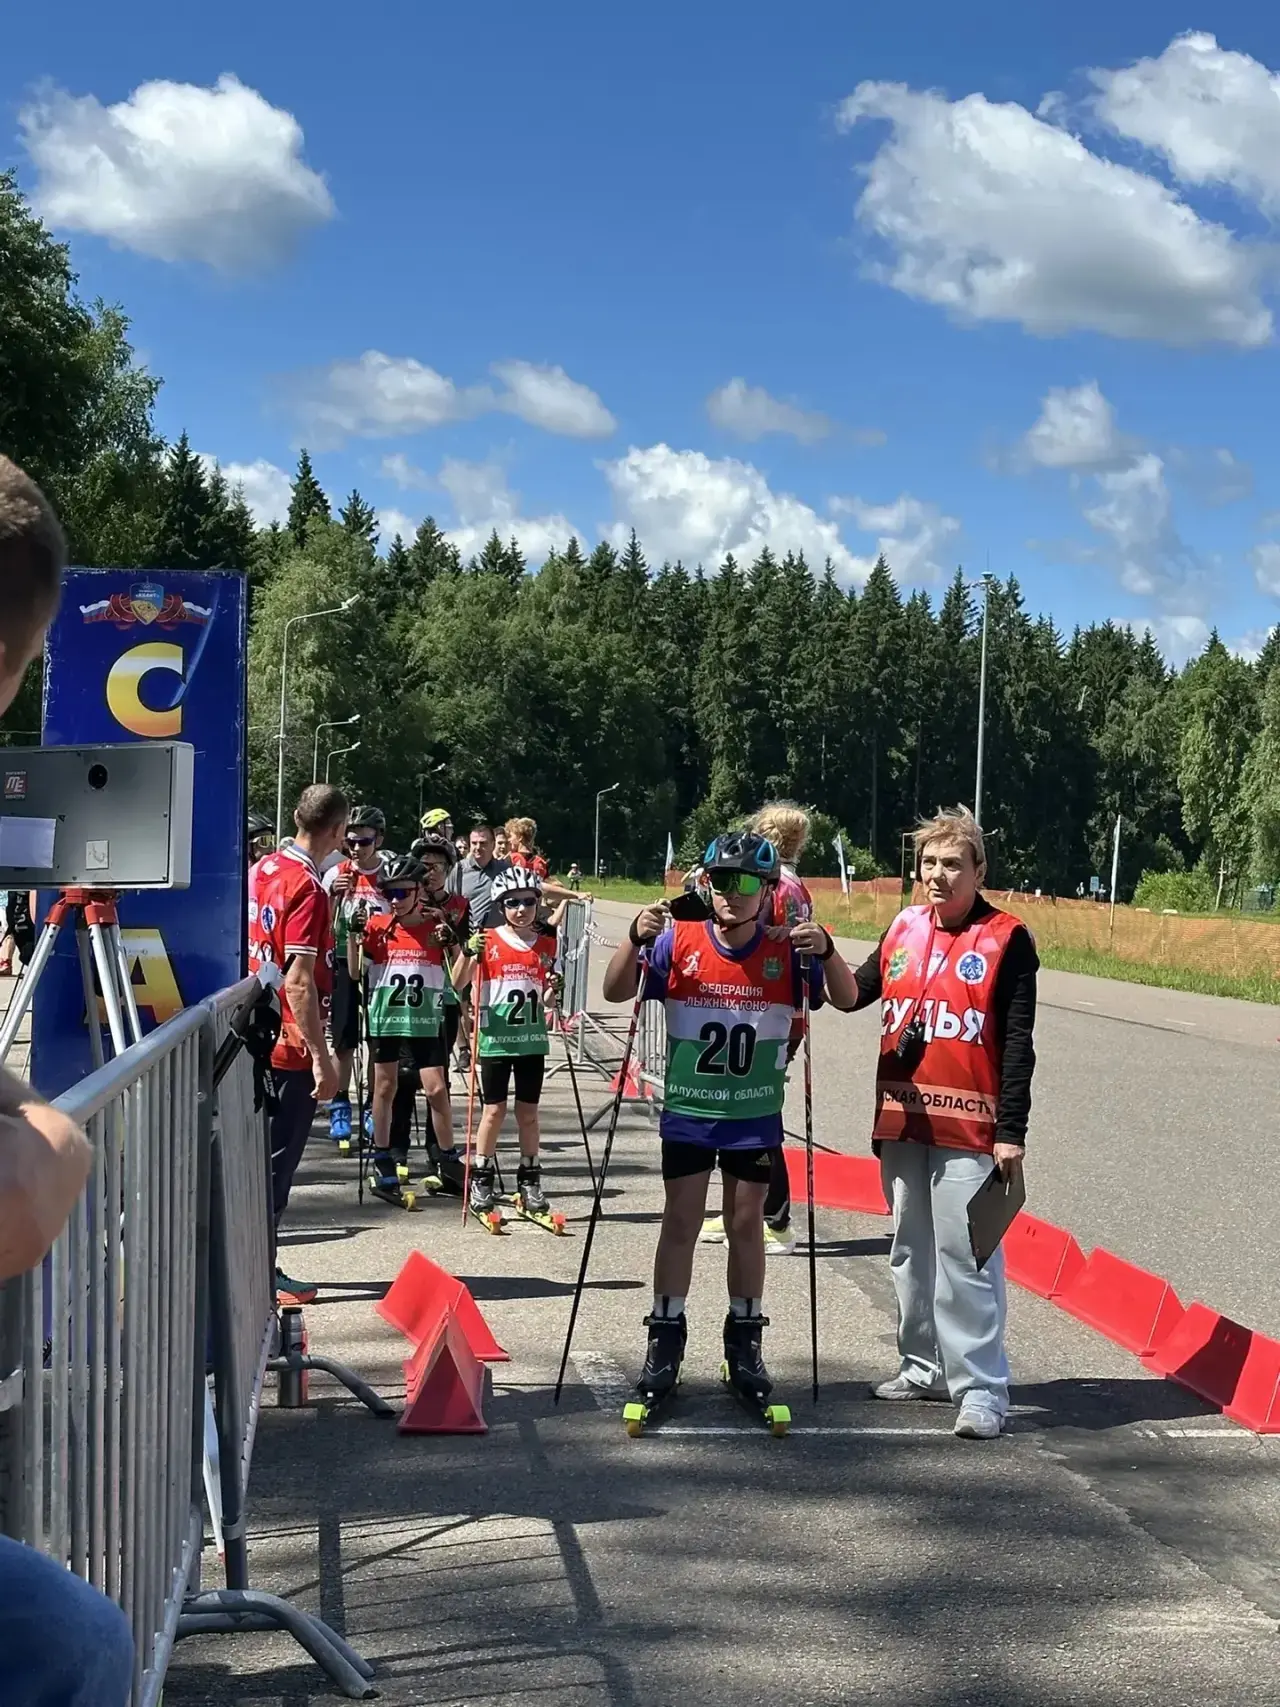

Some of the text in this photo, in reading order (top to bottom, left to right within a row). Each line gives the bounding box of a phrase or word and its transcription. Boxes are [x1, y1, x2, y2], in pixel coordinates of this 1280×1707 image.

[387, 972, 425, 1008] 23
[698, 982, 764, 997] ФЕДЕРАЦИЯ
[506, 988, 539, 1027] 21
[685, 996, 771, 1012] ЛЫЖНЫХ ГОНО
[694, 1020, 757, 1078] 20
[668, 1083, 730, 1101] КАЛУЖСКОЙ
[920, 1092, 993, 1115] ОБЛАСТЬ
